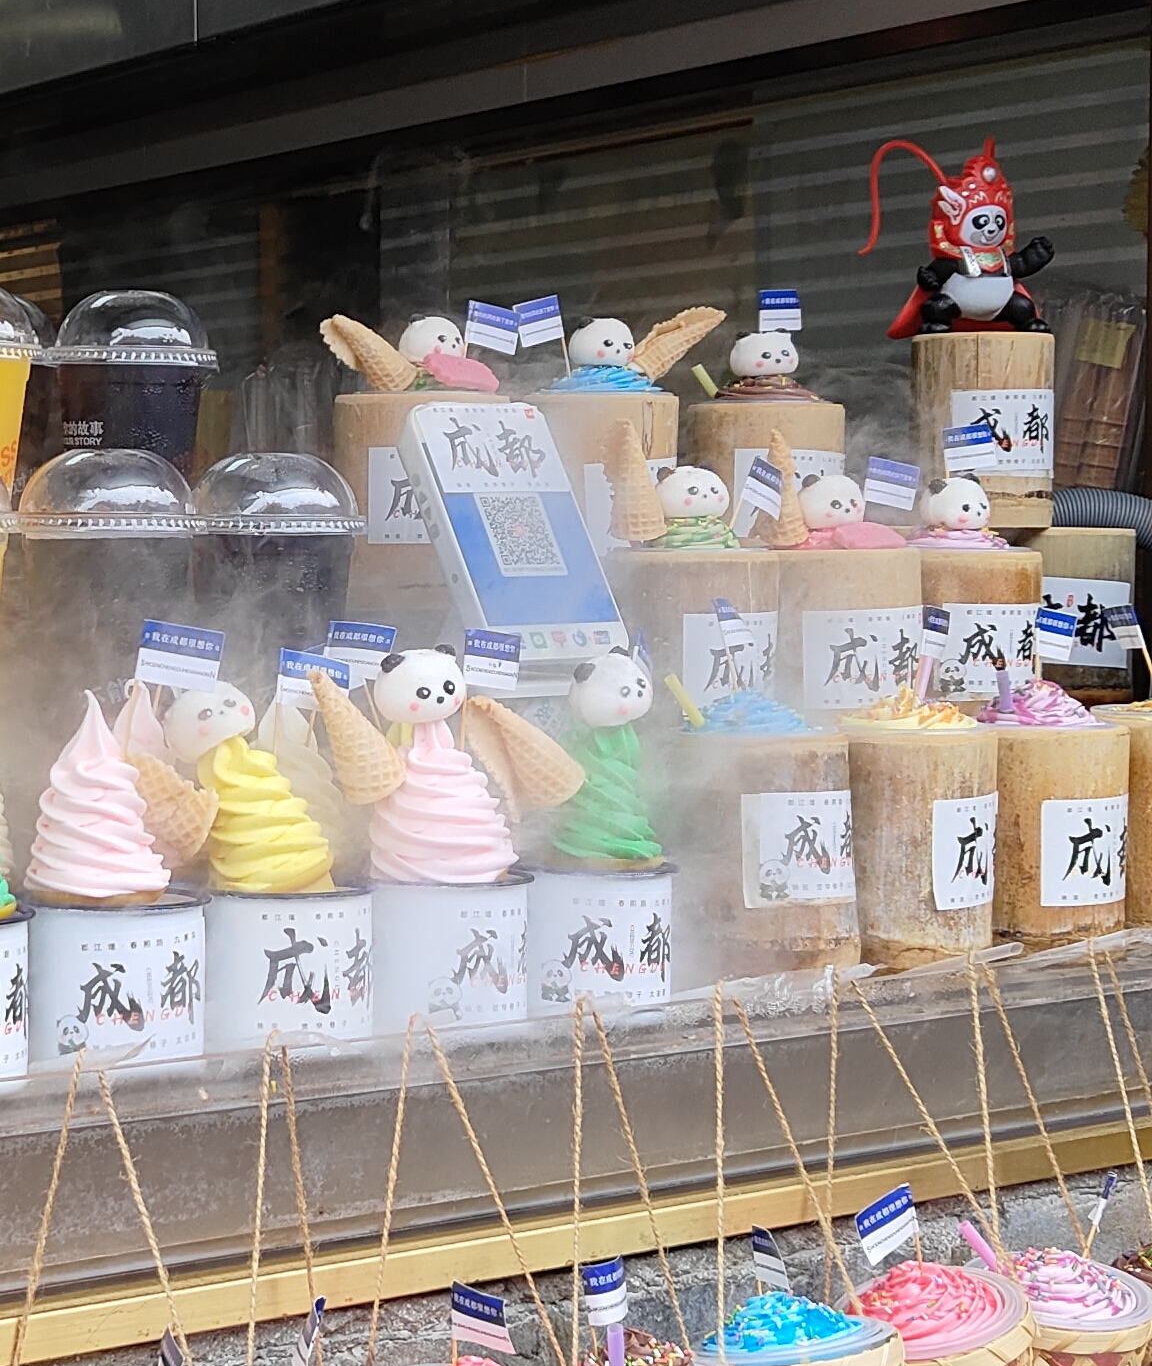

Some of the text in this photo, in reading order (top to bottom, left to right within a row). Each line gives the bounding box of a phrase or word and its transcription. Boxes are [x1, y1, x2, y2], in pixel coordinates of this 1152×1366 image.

[75, 436, 103, 446] STORY
[443, 416, 547, 479] 成都
[152, 631, 215, 651] 我在成都很想你
[333, 631, 385, 644] 我在成都很想你
[562, 912, 671, 982] 成都
[77, 951, 201, 1032] 成都
[453, 1291, 499, 1319] 我在成都很想你
